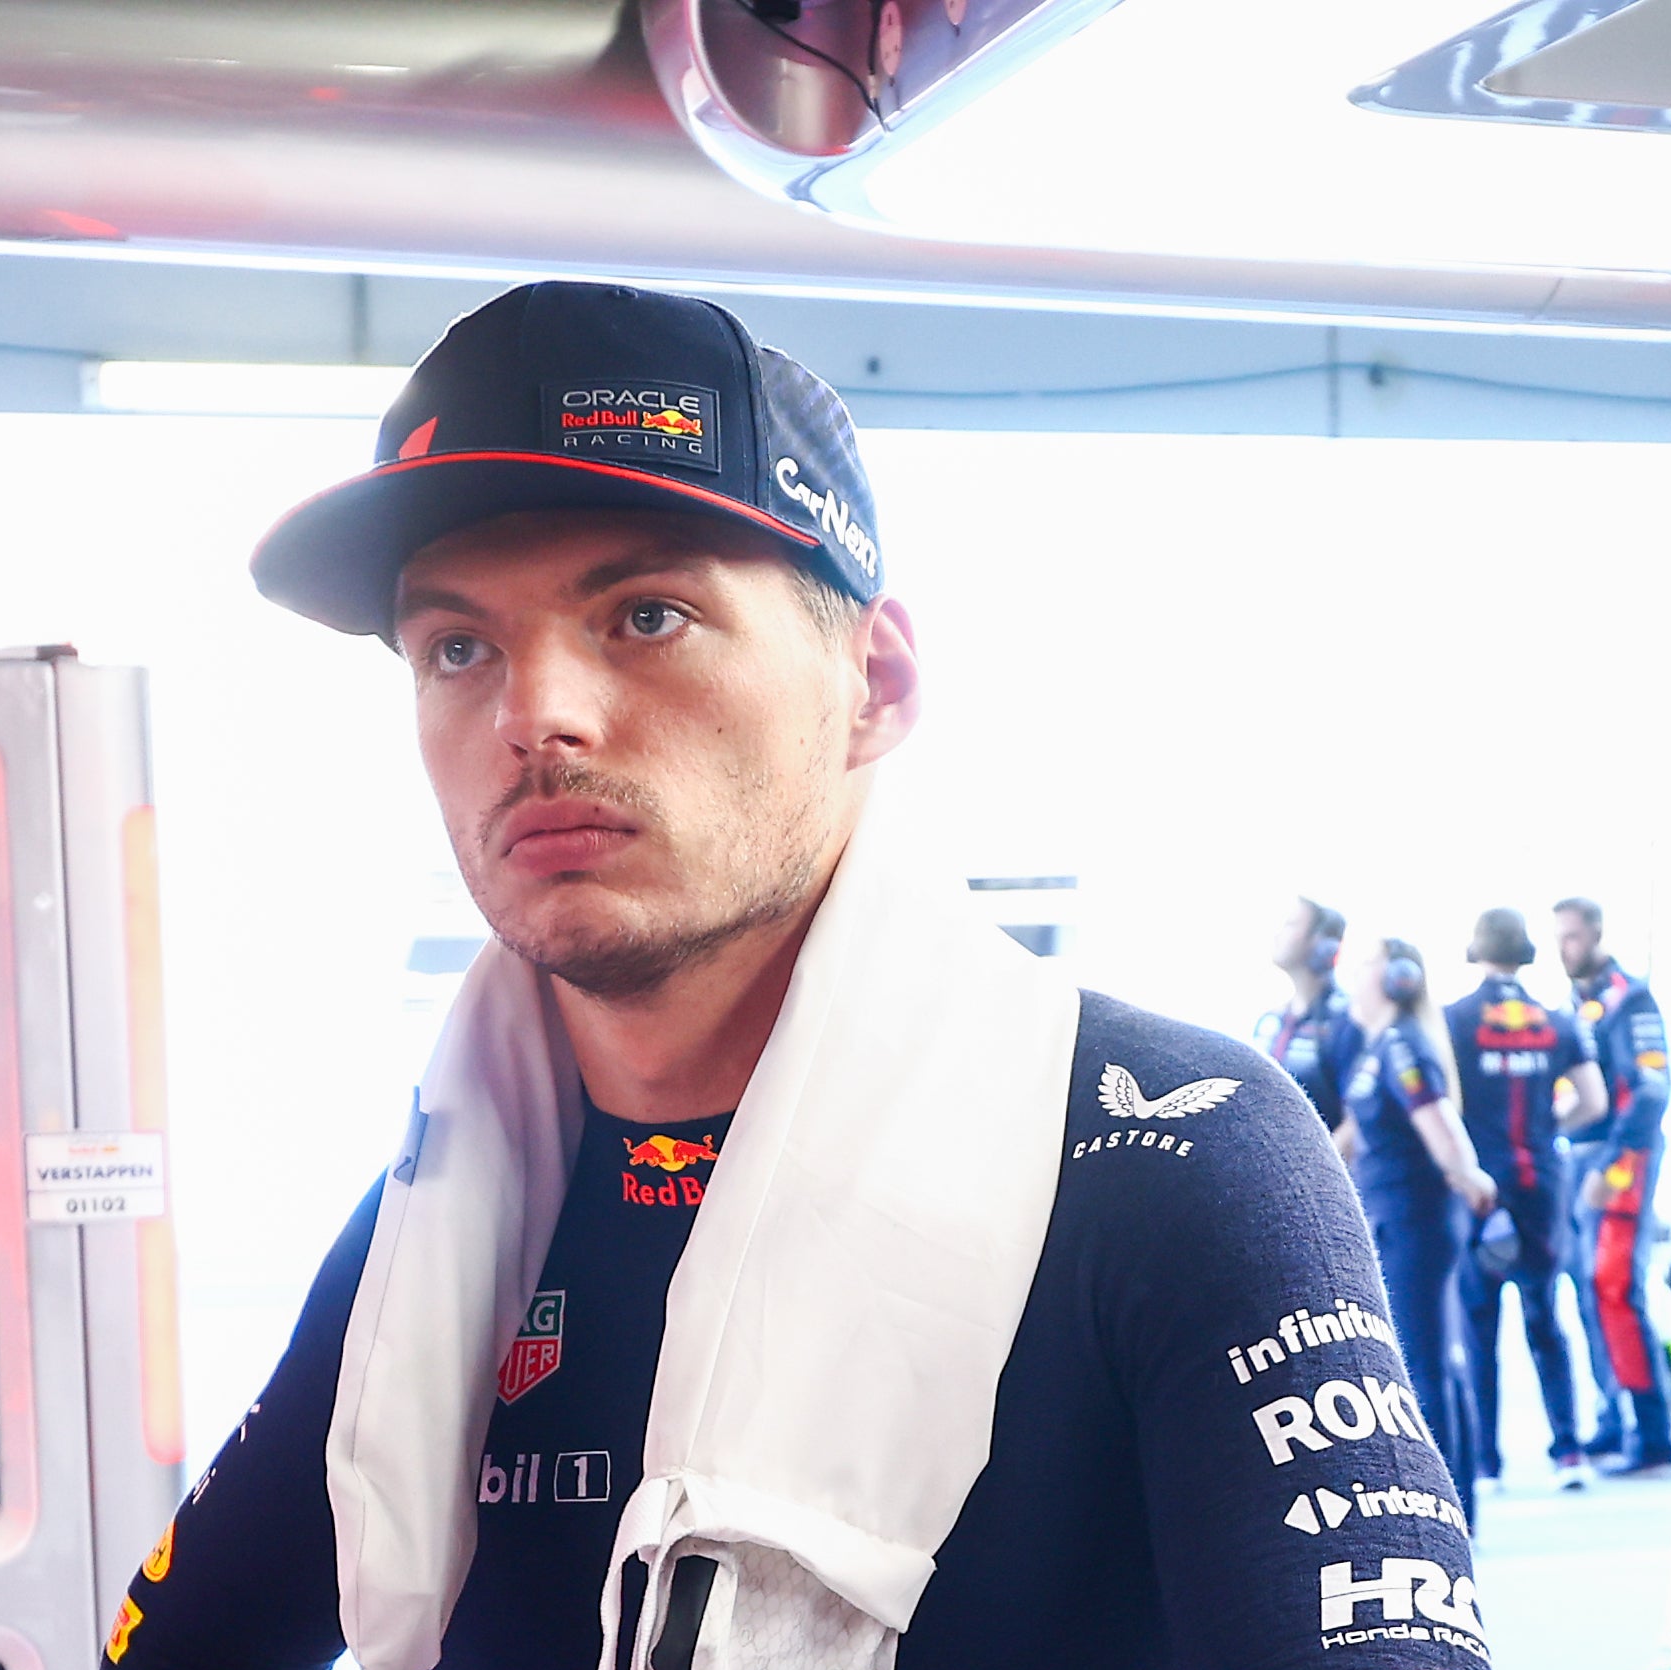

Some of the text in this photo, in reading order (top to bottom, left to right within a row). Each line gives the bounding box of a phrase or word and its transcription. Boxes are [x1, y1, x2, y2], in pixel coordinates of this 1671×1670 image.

[562, 389, 700, 414] ORACLE
[561, 410, 638, 428] Red Bull
[564, 434, 702, 454] RACING
[1073, 1129, 1194, 1159] CASTORE
[36, 1164, 154, 1181] VERSTAPPEN
[621, 1172, 678, 1207] Red
[503, 1344, 555, 1395] UER
[478, 1453, 541, 1503] bil
[1352, 1482, 1469, 1538] inter.m
[1321, 1623, 1431, 1650] Honda
